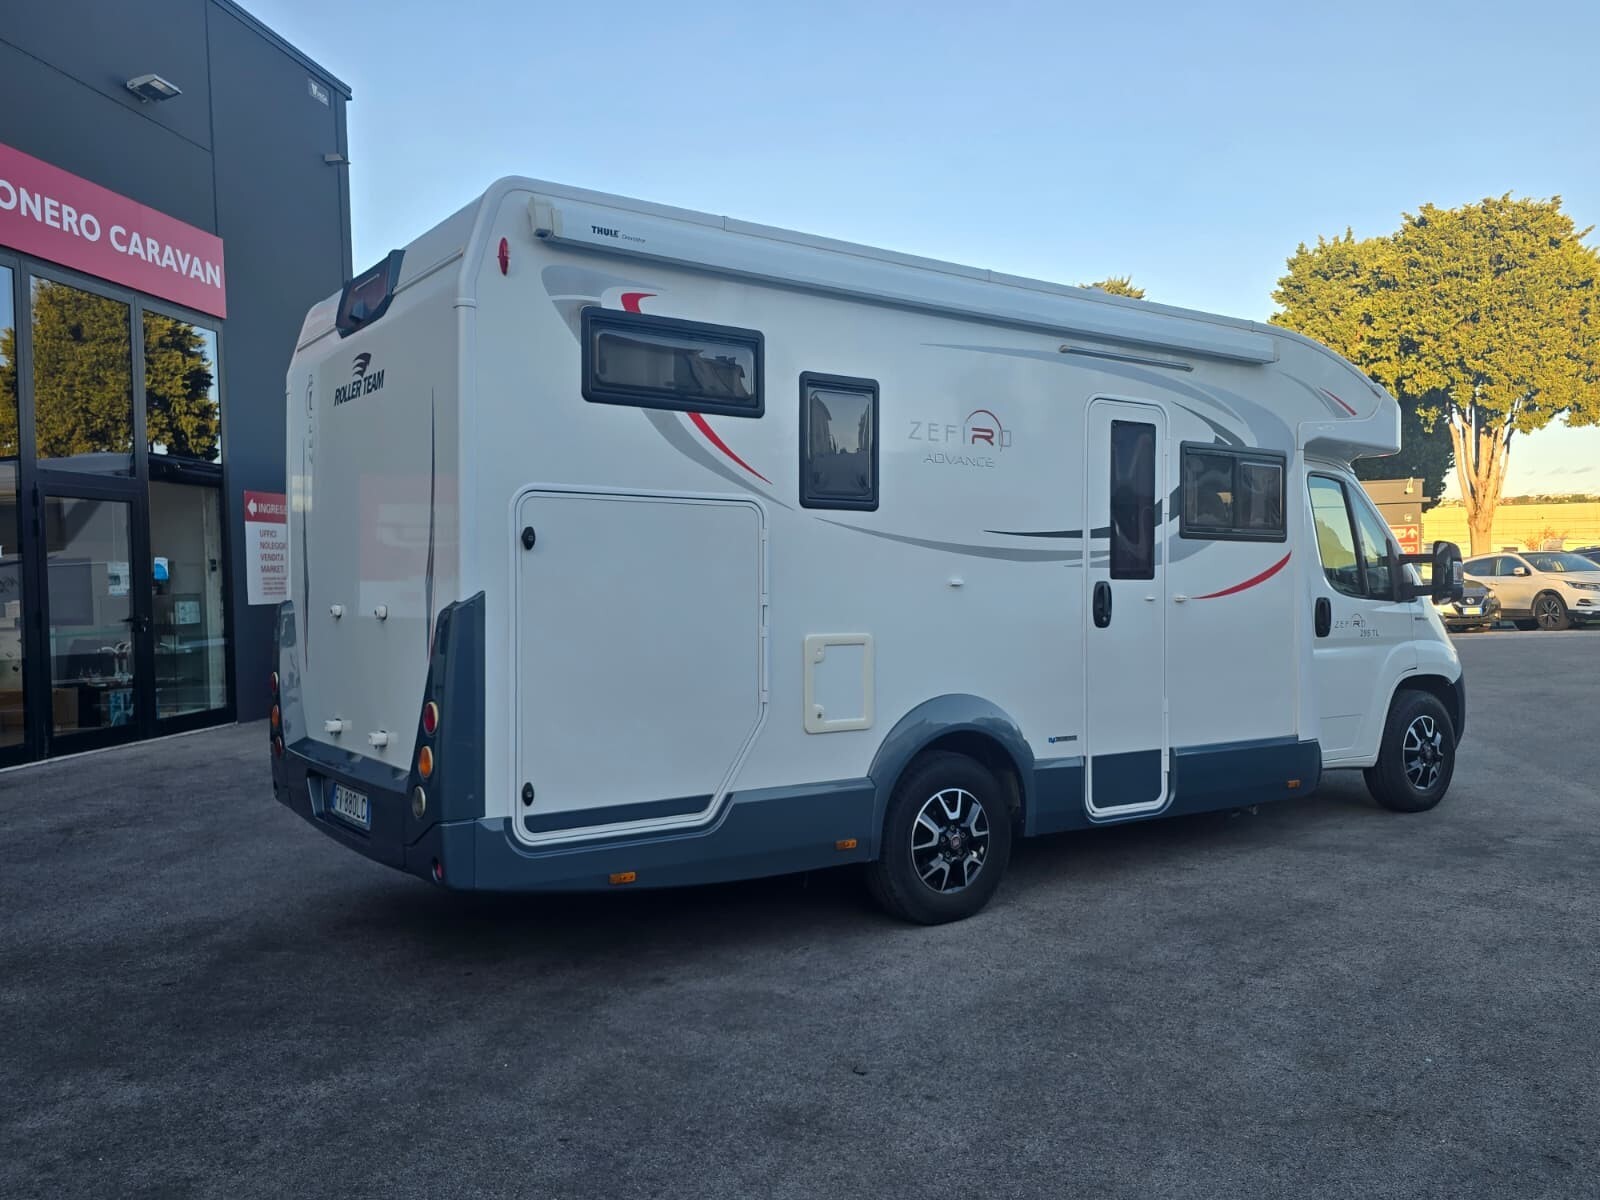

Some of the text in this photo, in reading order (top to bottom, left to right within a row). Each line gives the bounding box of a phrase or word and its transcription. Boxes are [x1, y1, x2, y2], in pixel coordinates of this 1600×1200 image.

[591, 225, 620, 238] THULE
[109, 225, 221, 289] CARAVAN
[334, 369, 384, 407] ROLLER TEAM
[923, 453, 995, 468] ADVANCE
[259, 529, 277, 538] UFFICI
[260, 553, 284, 562] VENDITA
[261, 565, 284, 574] MARKET
